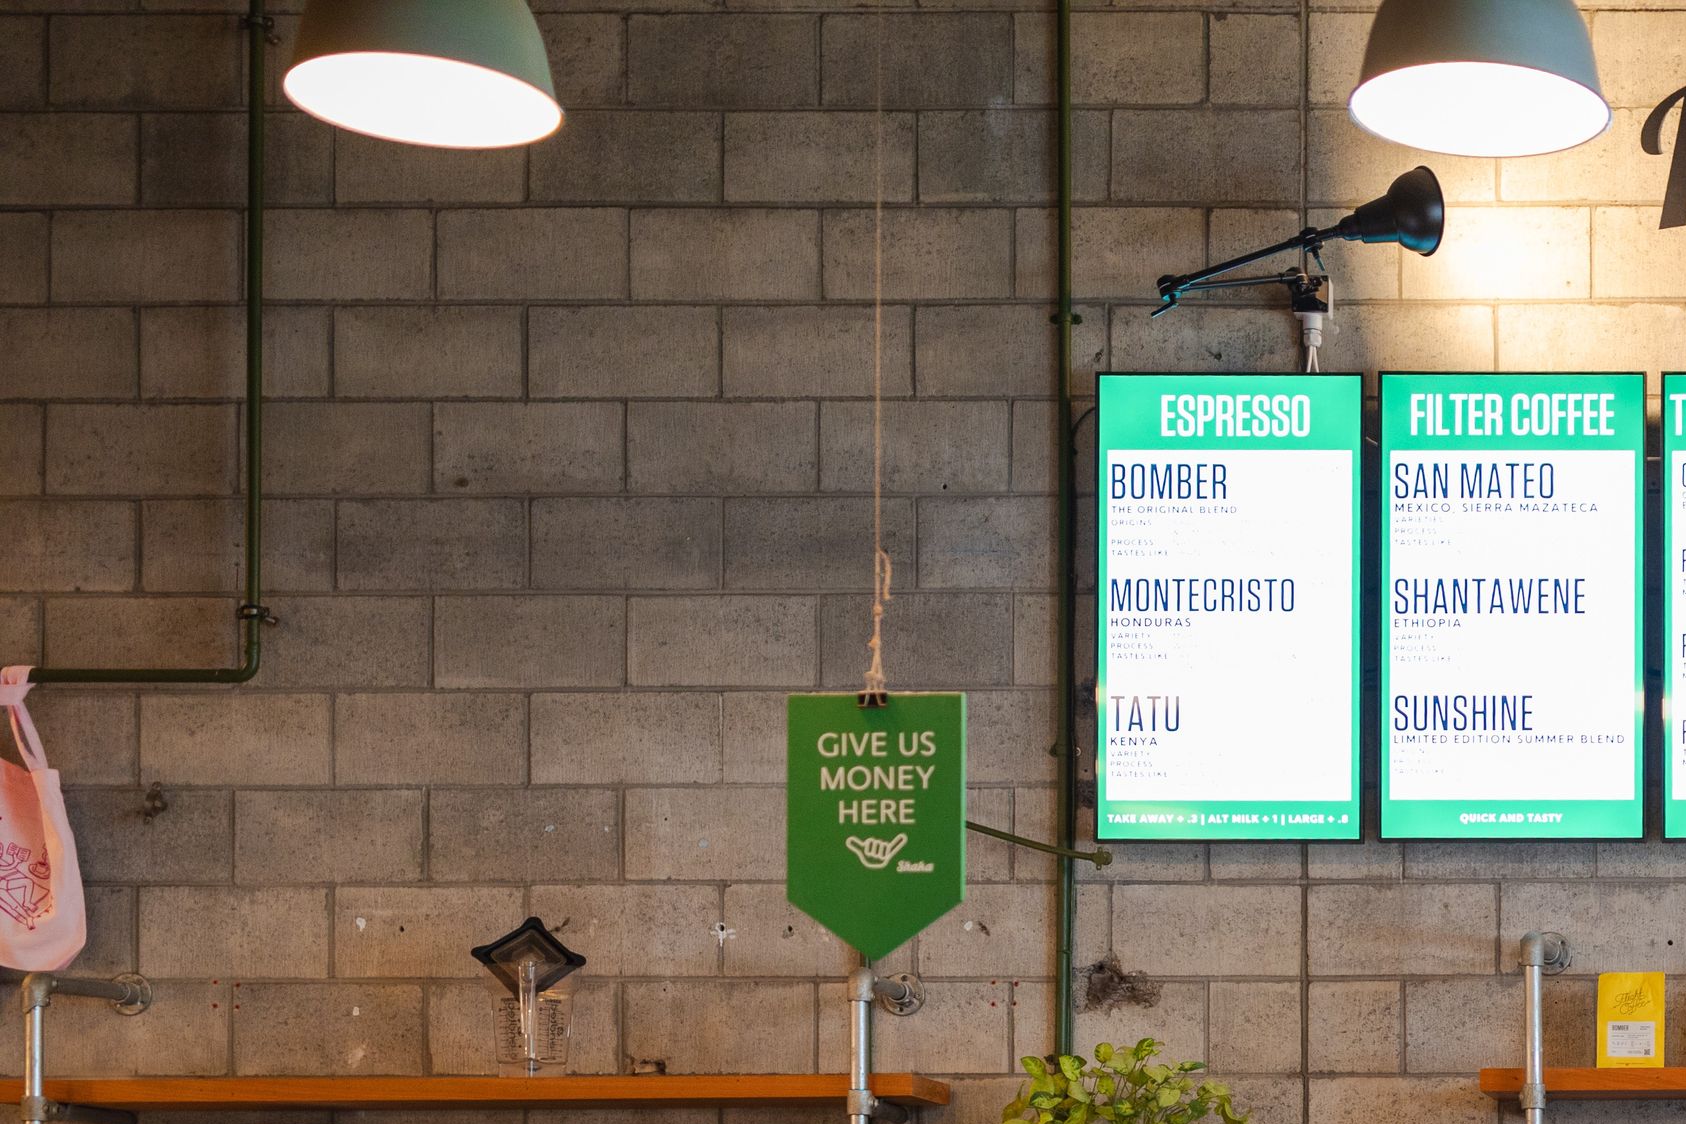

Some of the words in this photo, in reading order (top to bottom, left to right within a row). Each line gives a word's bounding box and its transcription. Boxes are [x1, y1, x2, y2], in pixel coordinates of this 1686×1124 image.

[1160, 394, 1310, 437] ESPRESSO
[1410, 393, 1503, 436] FILTER
[1511, 393, 1615, 436] COFFEE
[1111, 464, 1227, 499] BOMBER
[1395, 463, 1448, 499] SAN
[1461, 463, 1553, 499] MATEO
[1112, 506, 1131, 514] THE
[1138, 506, 1193, 514] ORIGINAL
[1200, 506, 1237, 514] BLEND
[1463, 503, 1512, 512] SIERRA
[1520, 503, 1598, 512] MAZATECA
[1111, 579, 1295, 611] MONTECRISTO
[1395, 579, 1585, 614] SHANTAWENE
[1111, 618, 1191, 627] HONDURAS
[1394, 618, 1461, 628] ETHIOPIA
[1111, 696, 1180, 732] TATU
[1395, 695, 1533, 731] SUNSHINE
[817, 732, 887, 757] GIVE
[899, 732, 936, 757] US
[1111, 737, 1157, 746] KENYA
[1394, 735, 1447, 744] LIMITED
[1455, 735, 1511, 744] EDITION
[1517, 735, 1573, 744] SUMMER
[1581, 735, 1624, 744] BLEND
[820, 766, 935, 791] MONEY
[839, 800, 915, 824] HERE
[1107, 814, 1136, 824] TAKE
[1139, 814, 1174, 824] AWAY
[1208, 814, 1229, 824] ALT
[1232, 814, 1259, 824] MILK
[1288, 814, 1325, 824] LARGE
[1459, 813, 1496, 824] QUICK
[1500, 813, 1524, 824] AND
[1527, 813, 1563, 824] TASTY
[896, 861, 934, 873] Shaka
